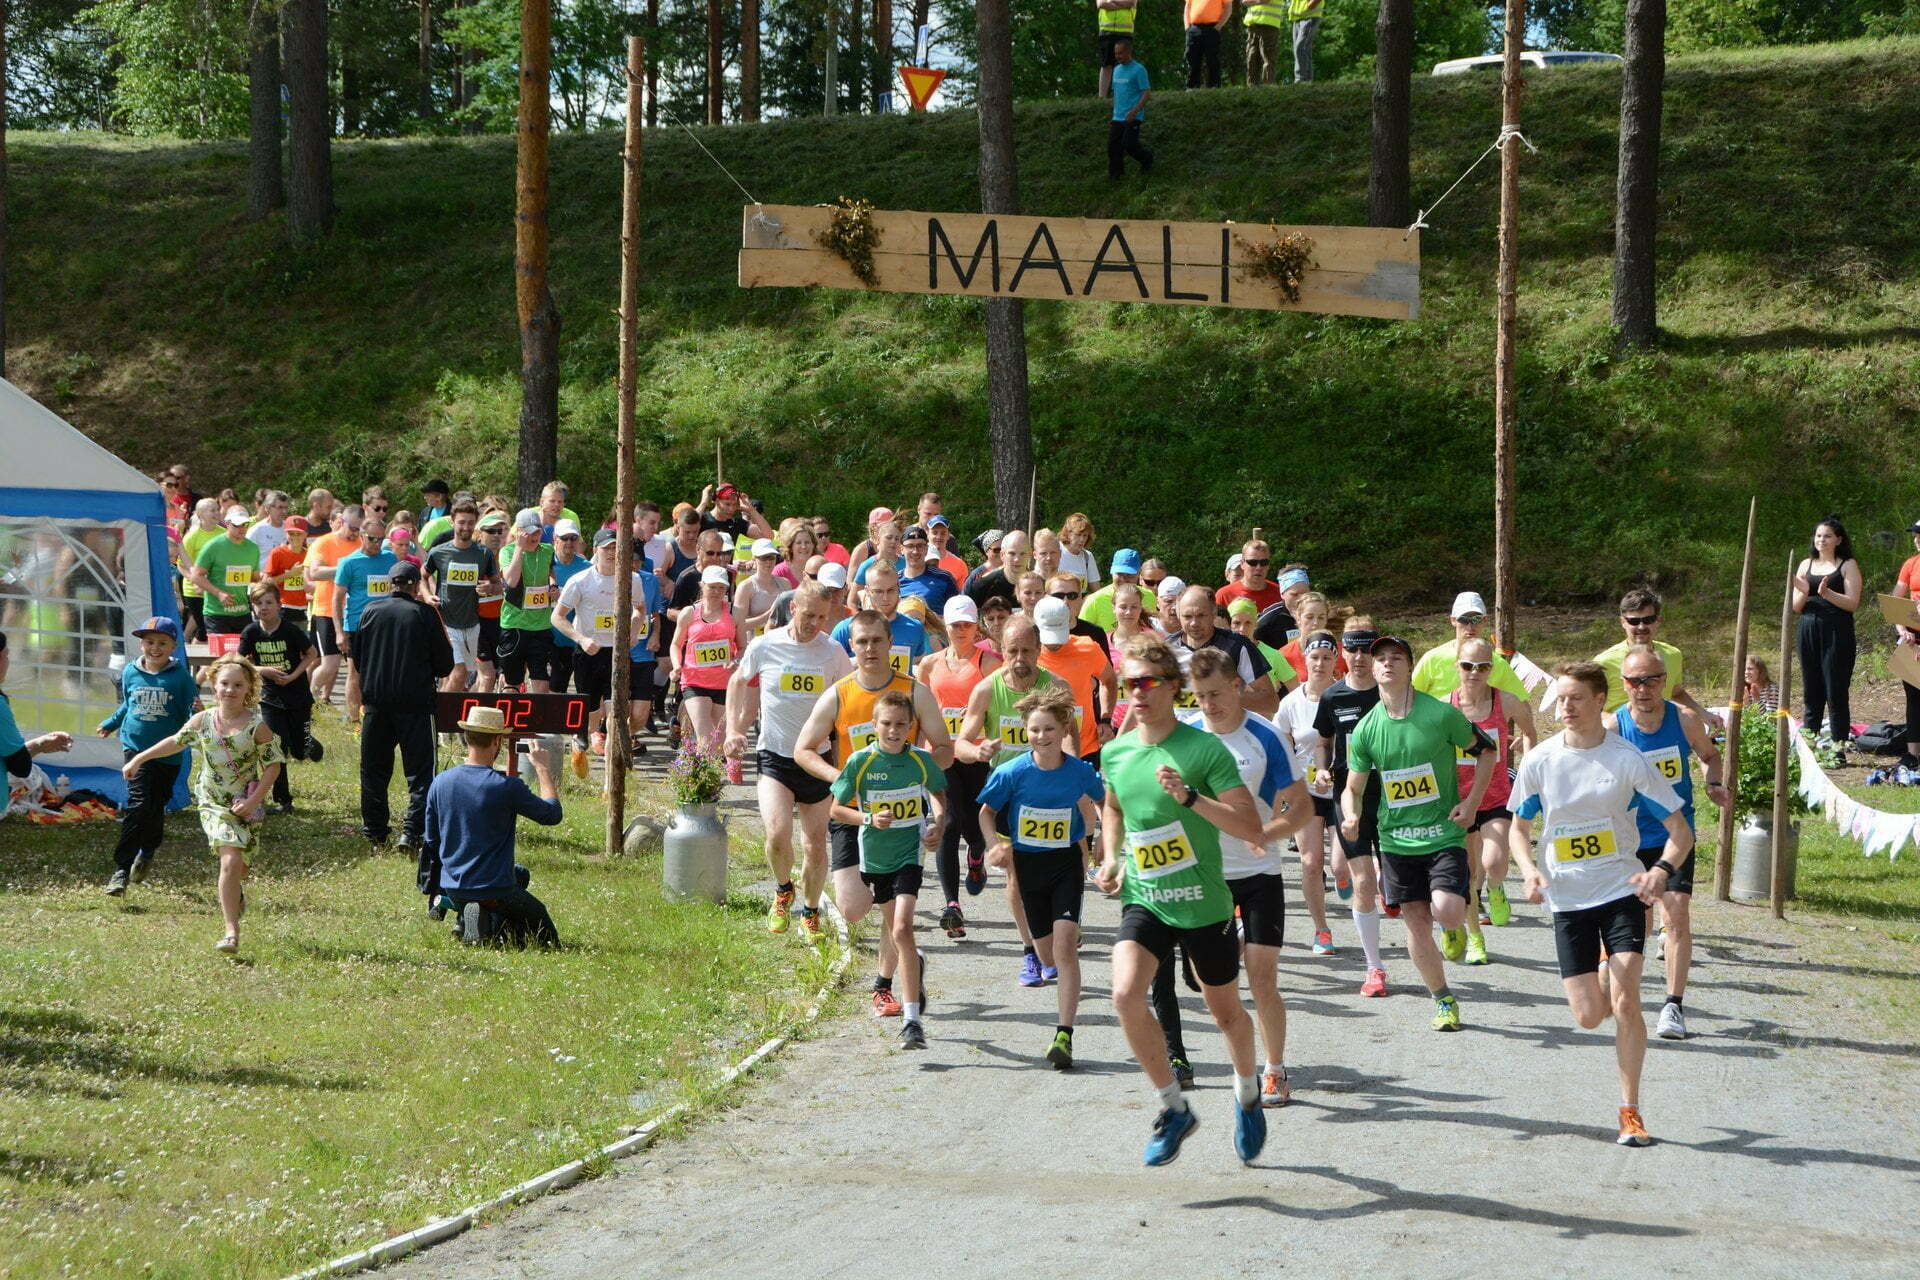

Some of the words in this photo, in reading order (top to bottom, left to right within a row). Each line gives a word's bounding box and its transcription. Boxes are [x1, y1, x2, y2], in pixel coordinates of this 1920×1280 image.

[929, 217, 1230, 303] MAALI
[233, 572, 245, 582] 61
[452, 570, 475, 582] 208
[700, 648, 726, 662] 130
[792, 675, 814, 692] 86
[566, 701, 584, 728] 0
[866, 772, 888, 781] INFO
[1391, 777, 1431, 800] 204
[1025, 820, 1064, 840] 216
[1391, 825, 1444, 839] HAPPEE
[1139, 839, 1184, 869] 205
[1570, 835, 1601, 859] 58
[1143, 885, 1204, 904] HAPPEE
